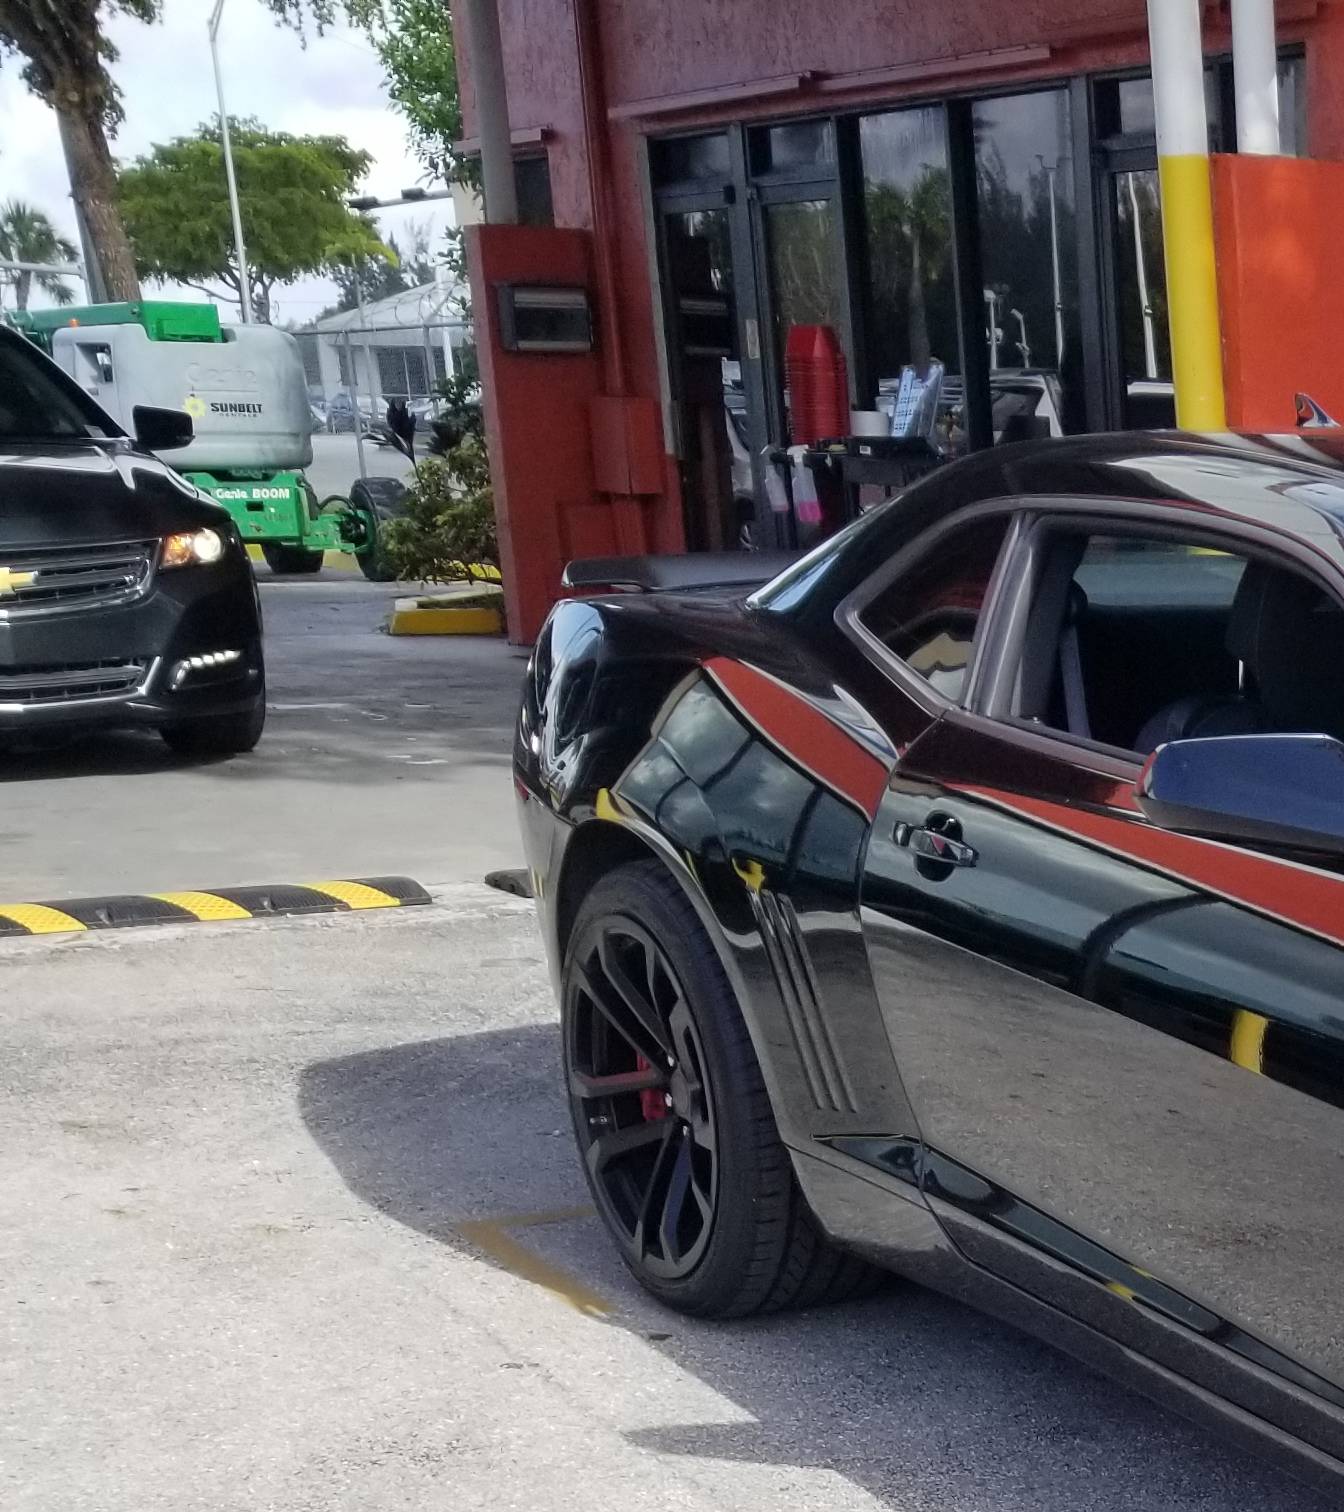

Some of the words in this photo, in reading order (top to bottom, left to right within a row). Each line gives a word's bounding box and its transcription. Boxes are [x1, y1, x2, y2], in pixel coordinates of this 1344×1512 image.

[210, 402, 263, 414] SUNBELT
[215, 487, 248, 499] Genie
[251, 487, 291, 499] BOOM
